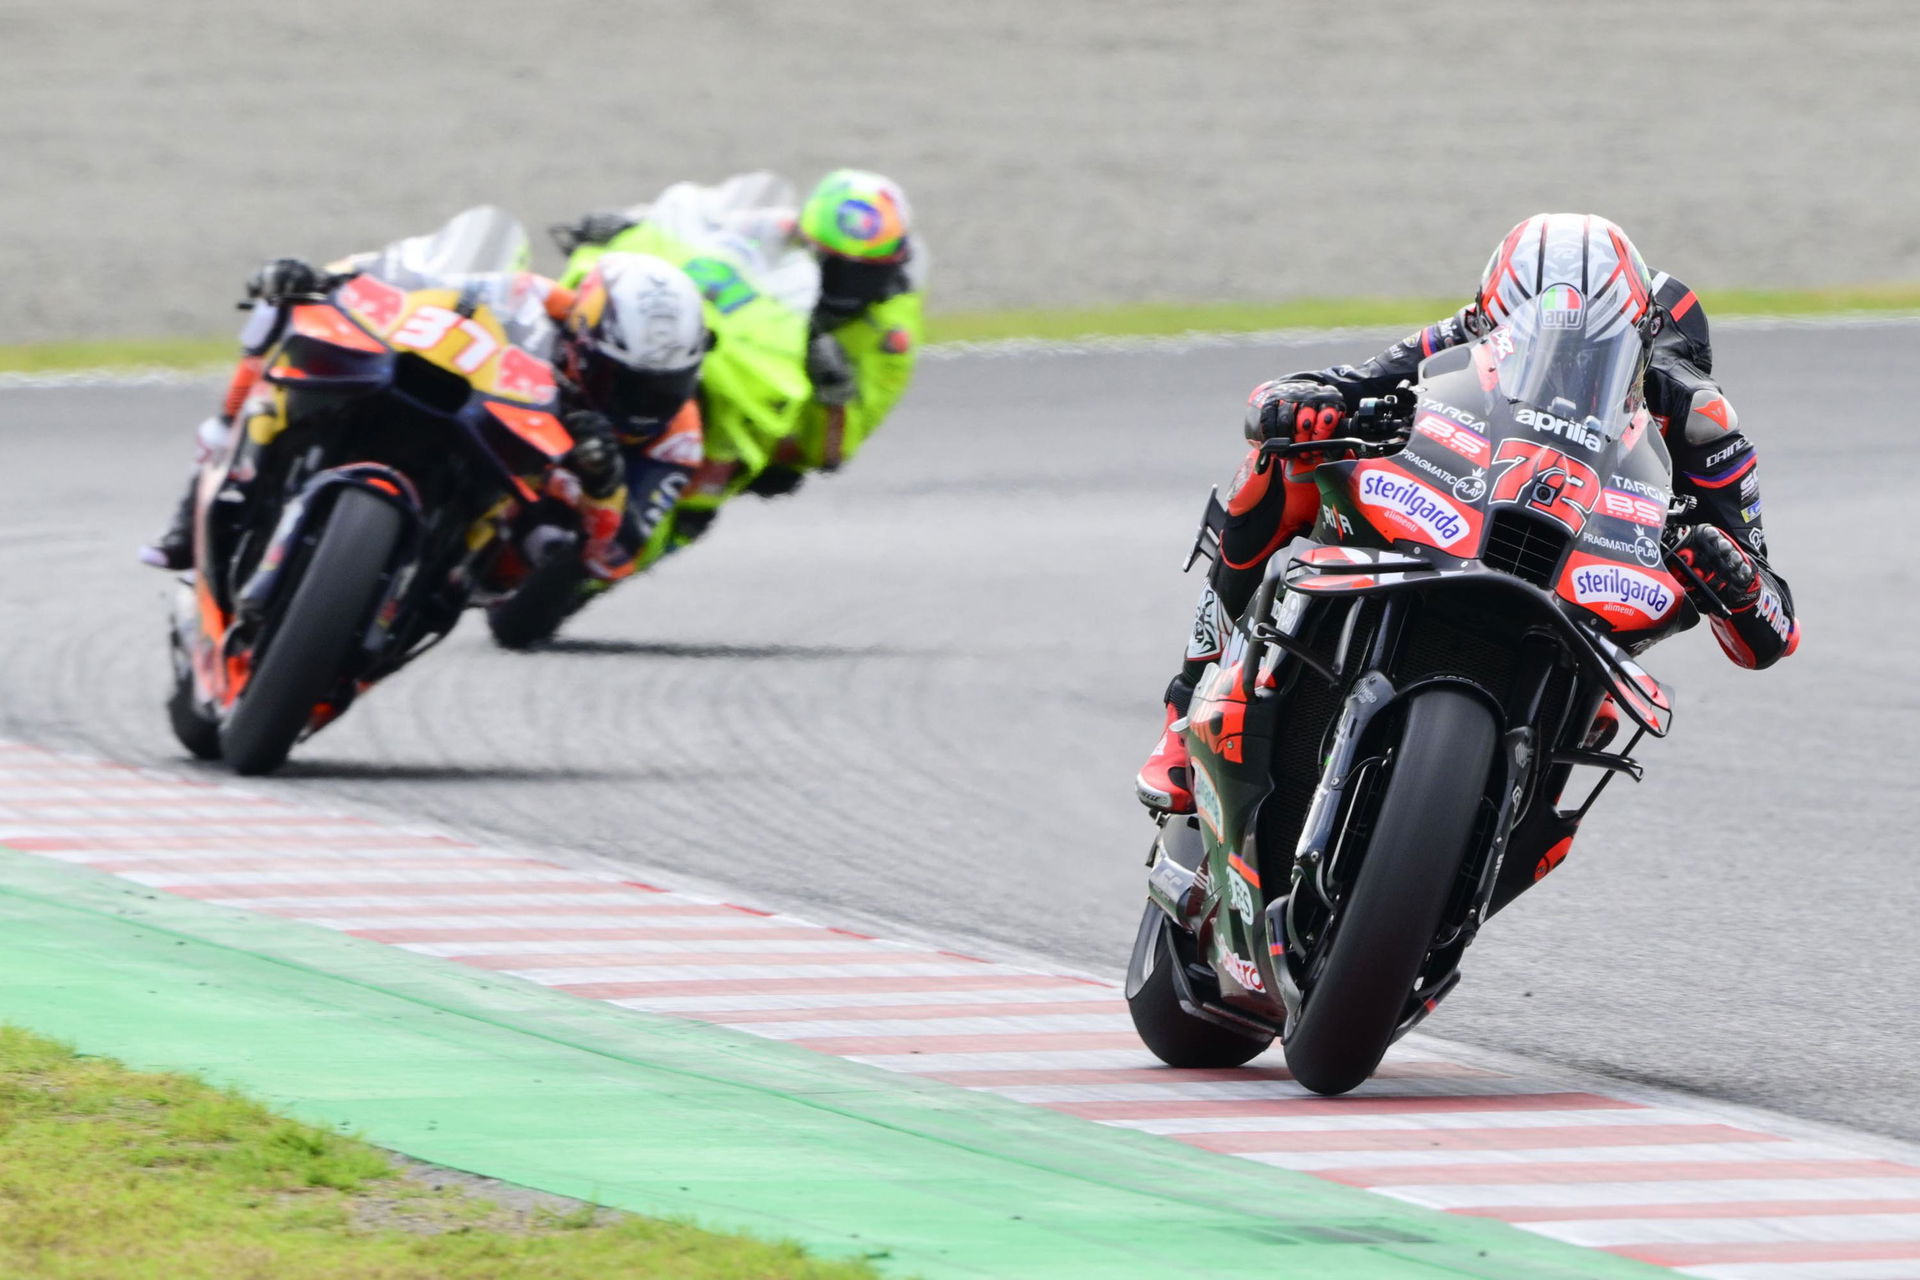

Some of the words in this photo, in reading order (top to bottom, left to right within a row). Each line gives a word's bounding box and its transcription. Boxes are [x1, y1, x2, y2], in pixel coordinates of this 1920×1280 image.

[391, 304, 498, 373] 37
[1545, 310, 1579, 327] agv
[1418, 415, 1486, 455] BS
[1419, 399, 1486, 433] TARGA
[1515, 408, 1602, 453] aprilia
[1400, 448, 1458, 485] PRAGMATIC
[1456, 481, 1482, 498] PLAY
[1488, 437, 1601, 538] 72
[1364, 475, 1461, 540] sterilgarda
[1384, 509, 1419, 533] alimenti
[1604, 492, 1661, 522] BS
[1583, 532, 1636, 554] PRAGMATIC
[1637, 545, 1658, 559] PLAY
[1577, 568, 1668, 612] sterilgarda
[1603, 603, 1636, 616] alimenti
